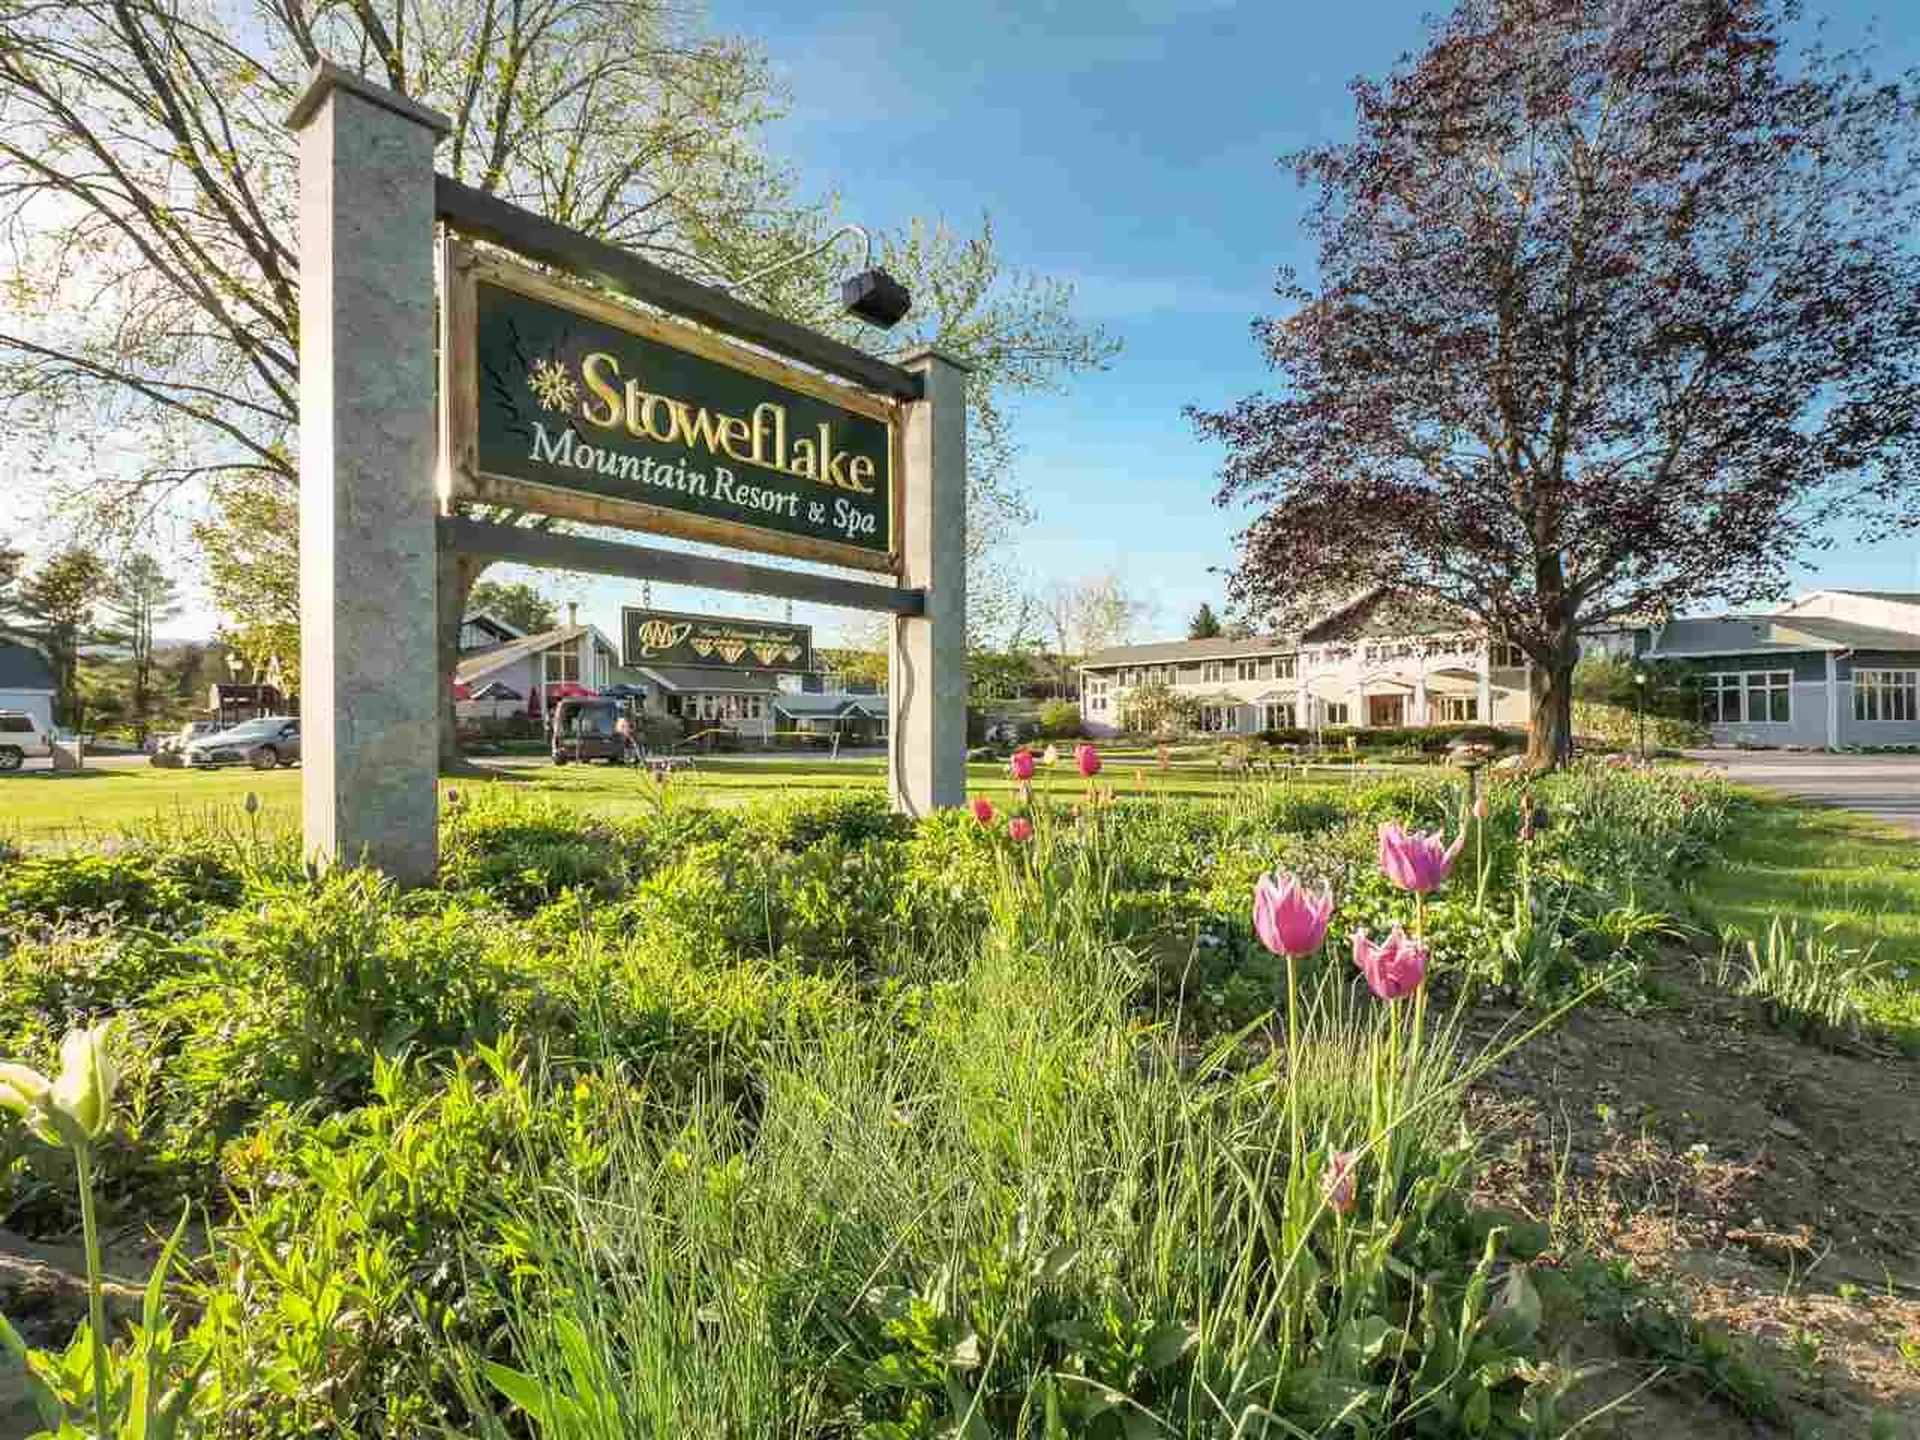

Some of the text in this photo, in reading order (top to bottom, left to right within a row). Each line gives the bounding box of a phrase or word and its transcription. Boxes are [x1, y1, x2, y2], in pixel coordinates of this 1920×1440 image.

[528, 420, 877, 536] Mountain Resort & Spa
[580, 352, 876, 493] Stoweflake
